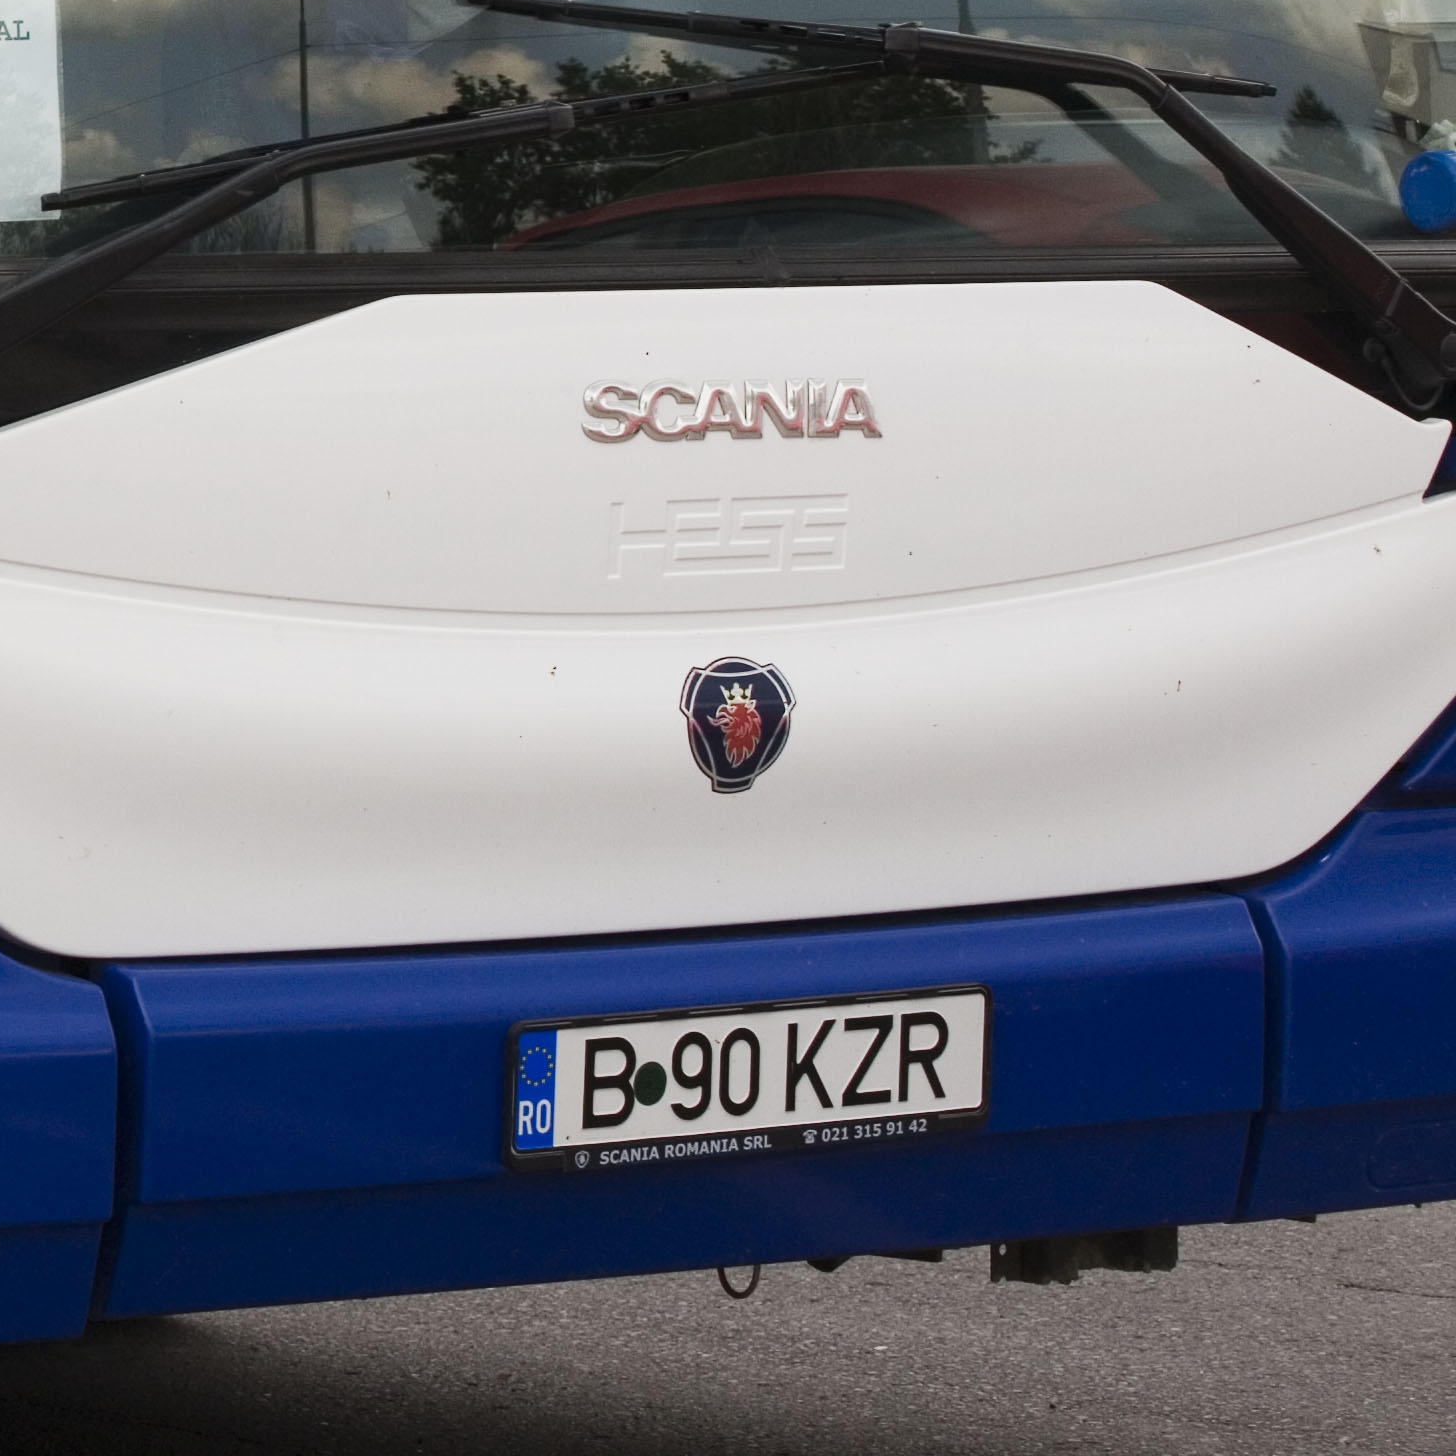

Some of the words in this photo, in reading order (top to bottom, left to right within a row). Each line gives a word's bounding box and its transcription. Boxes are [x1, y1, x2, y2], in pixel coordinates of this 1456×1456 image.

[581, 378, 883, 443] SCANIA
[607, 493, 849, 580] HESS
[582, 1035, 636, 1130] B
[670, 1027, 761, 1122] 90
[784, 1010, 949, 1112] KZR
[518, 1100, 552, 1136] RO
[599, 1145, 660, 1165] SCANIA
[664, 1138, 739, 1158] ROMANIA
[743, 1134, 772, 1150] SRL
[821, 1127, 849, 1142] 021
[854, 1123, 882, 1139] 315
[885, 1120, 904, 1136] 91
[908, 1118, 928, 1133] 42
